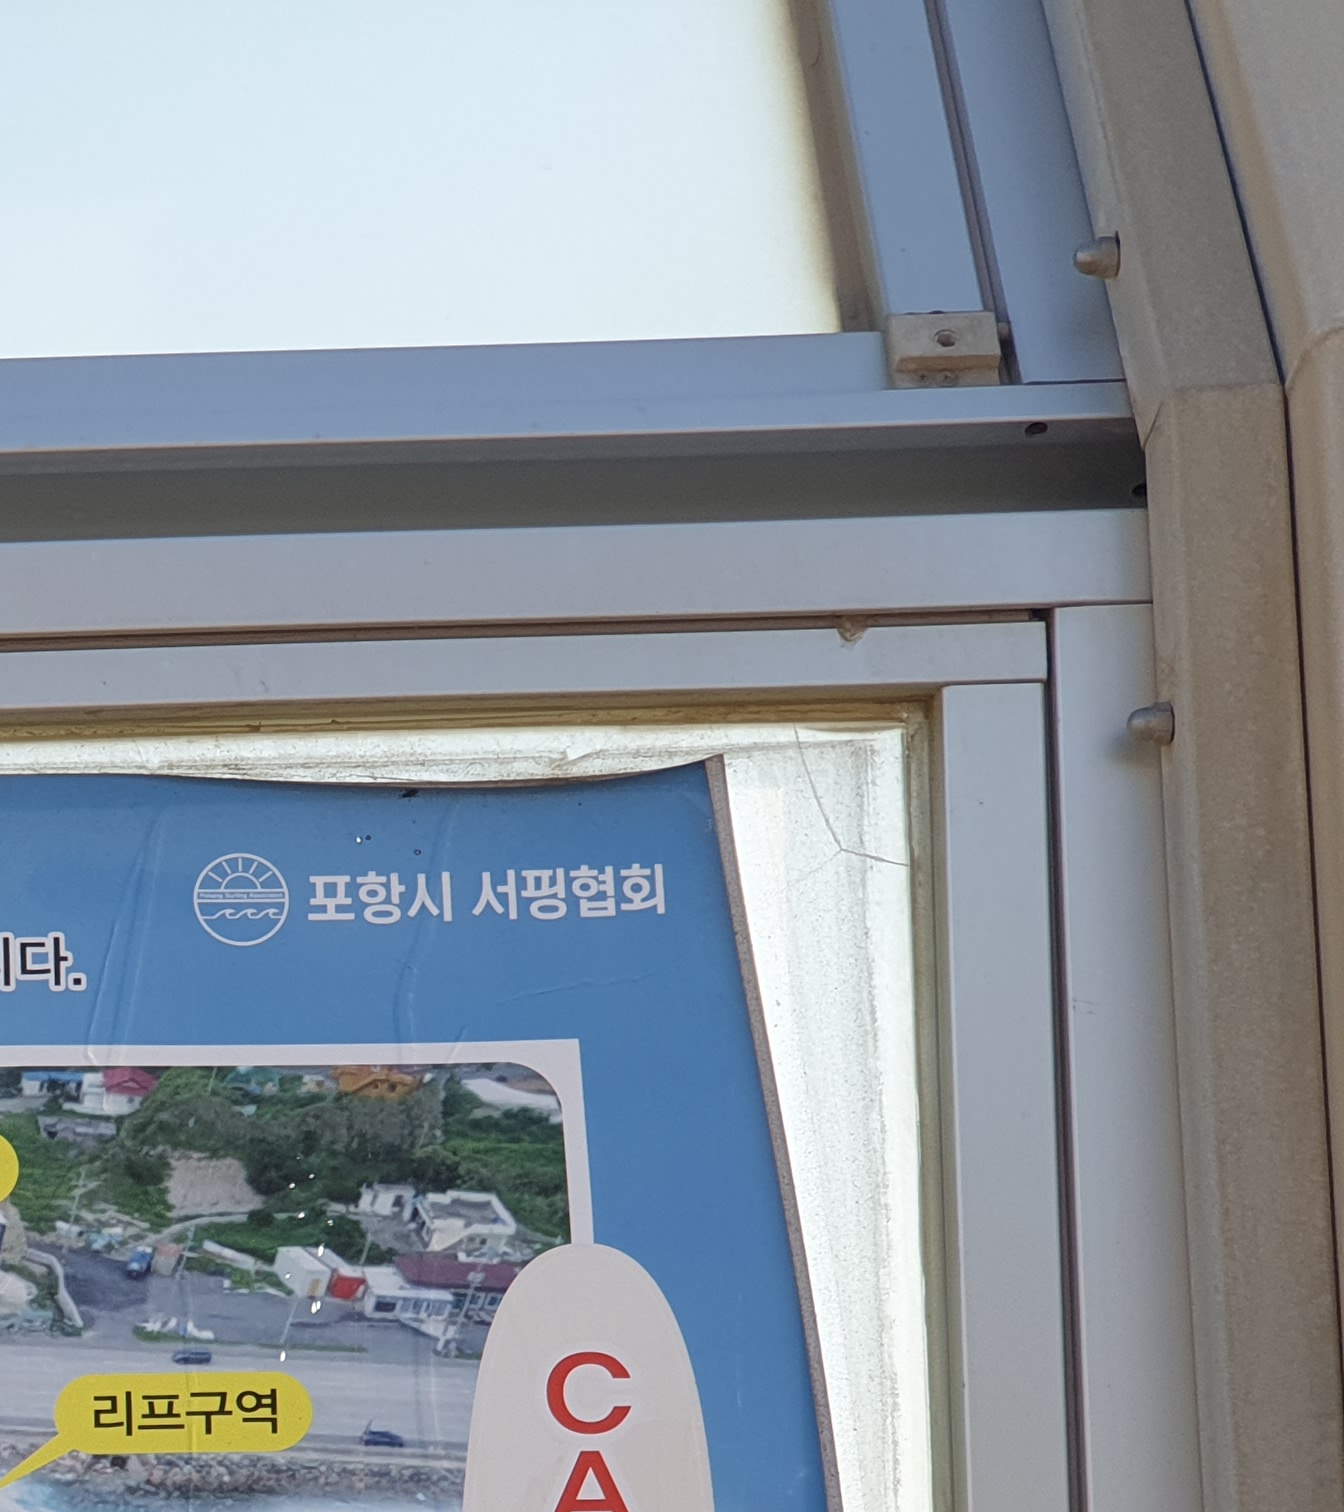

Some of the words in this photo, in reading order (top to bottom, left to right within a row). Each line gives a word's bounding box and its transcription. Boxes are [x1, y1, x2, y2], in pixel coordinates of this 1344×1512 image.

[308, 871, 453, 922] 포항시
[473, 864, 666, 919] 서핑협회
[92, 1388, 279, 1436] 리프구역
